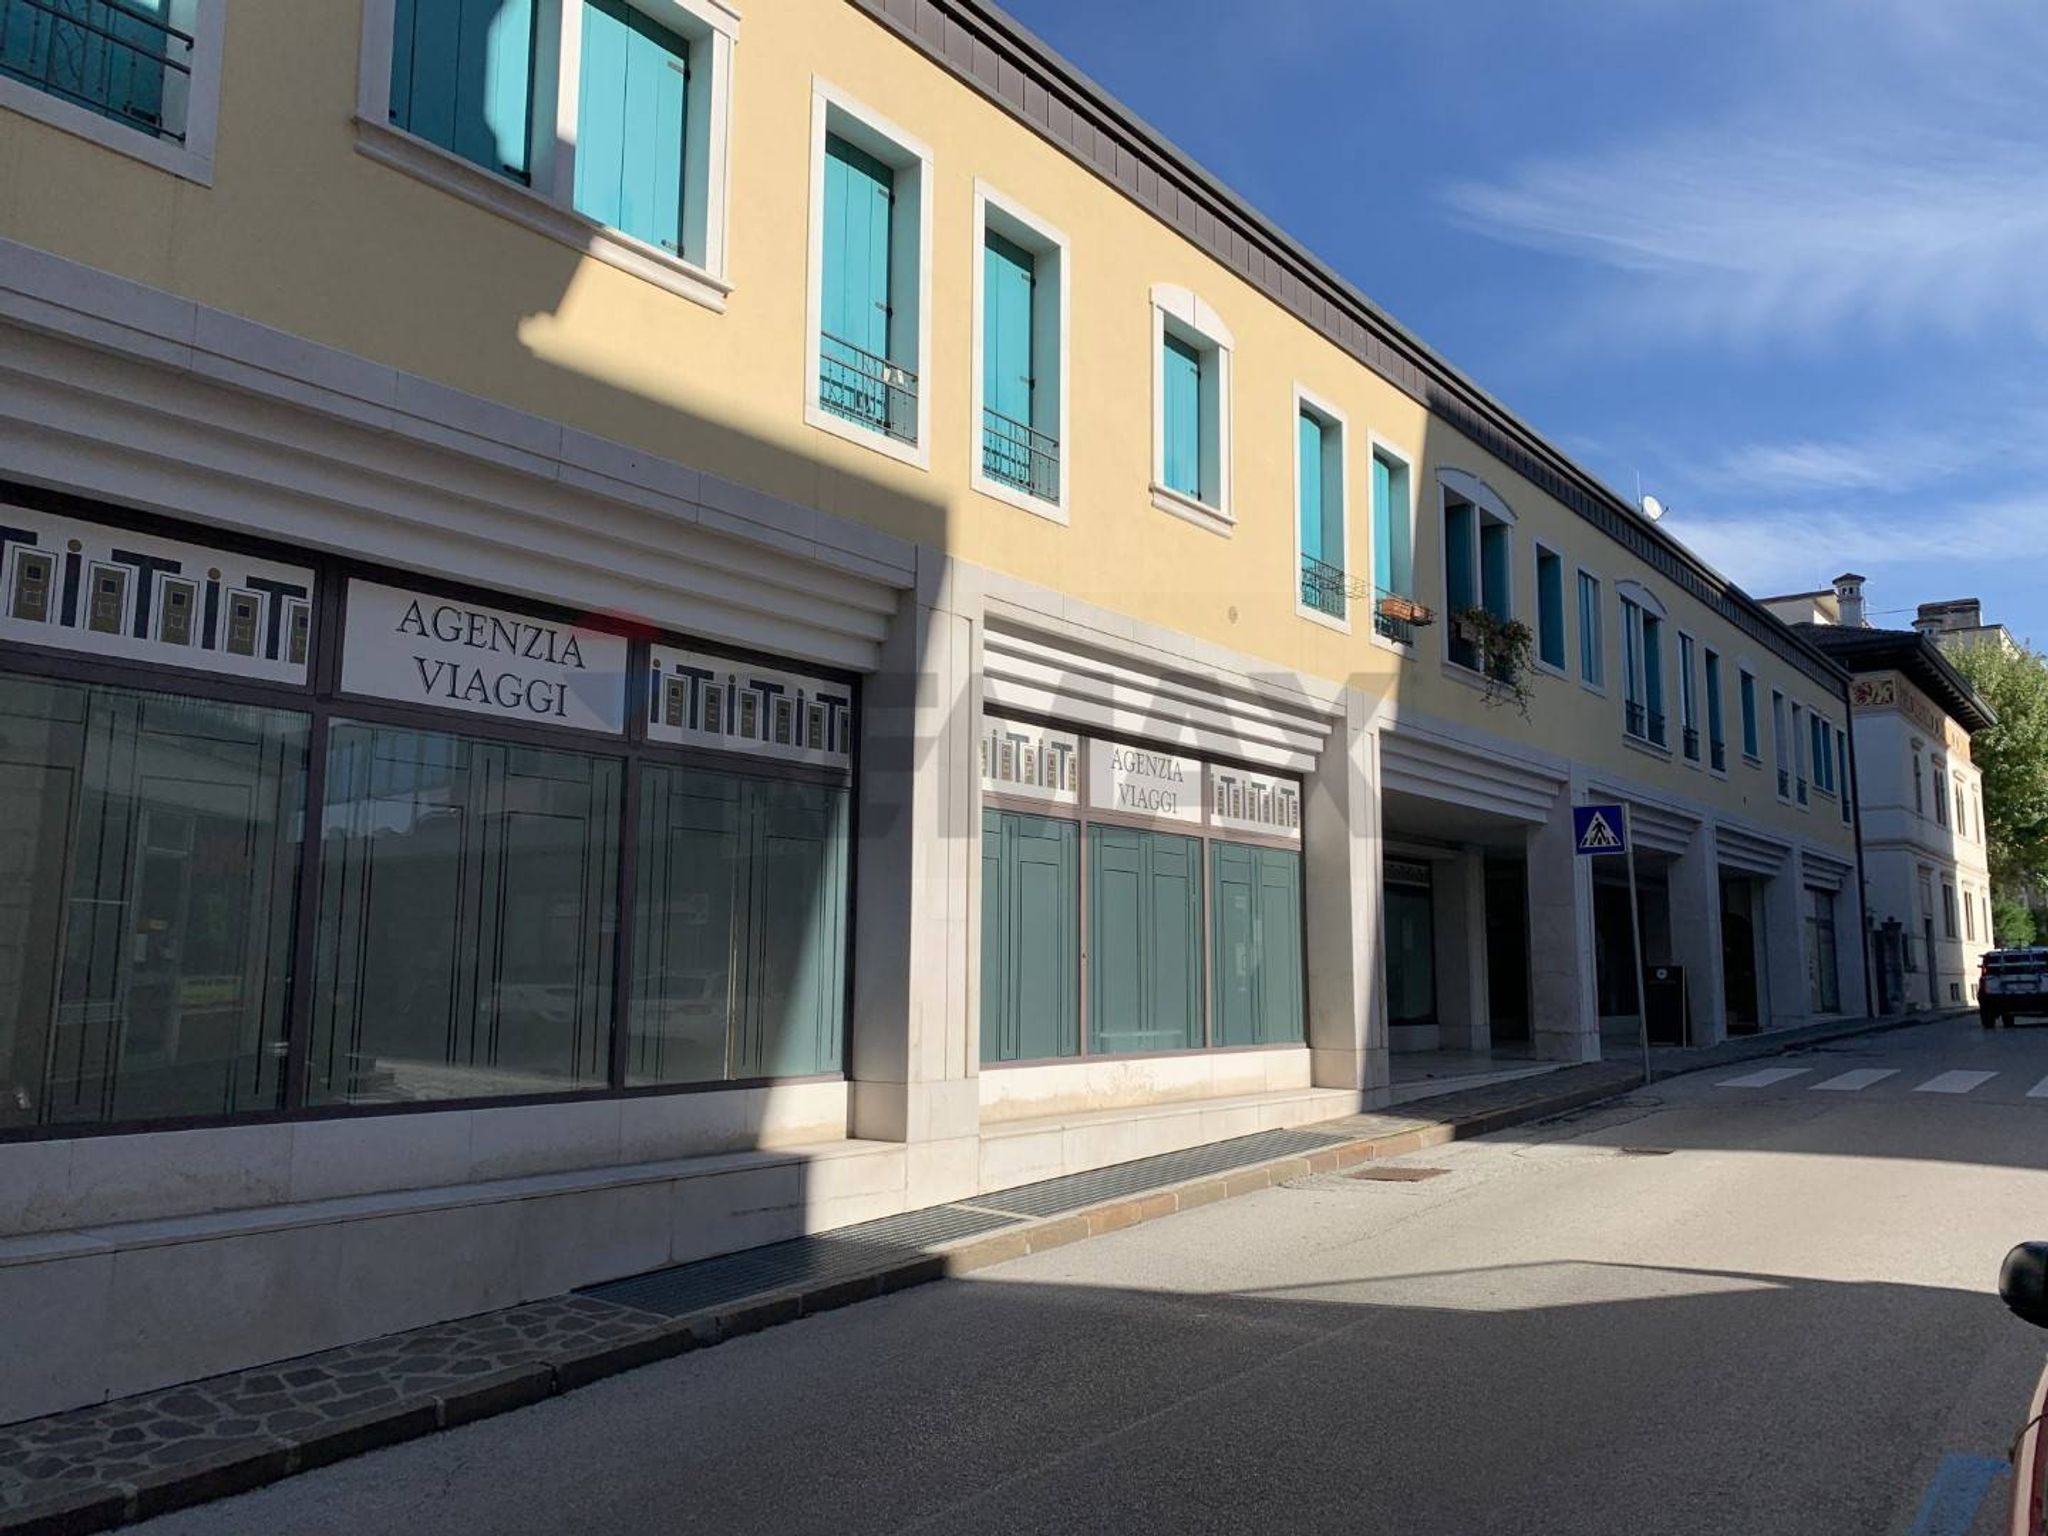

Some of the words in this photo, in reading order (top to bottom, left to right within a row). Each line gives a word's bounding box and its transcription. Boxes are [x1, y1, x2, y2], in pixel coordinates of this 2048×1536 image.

[396, 599, 586, 669] AGENZIA
[412, 655, 568, 717] VIAGGI
[1110, 747, 1184, 783] AGENZIA
[1118, 783, 1177, 814] VIAGGI
